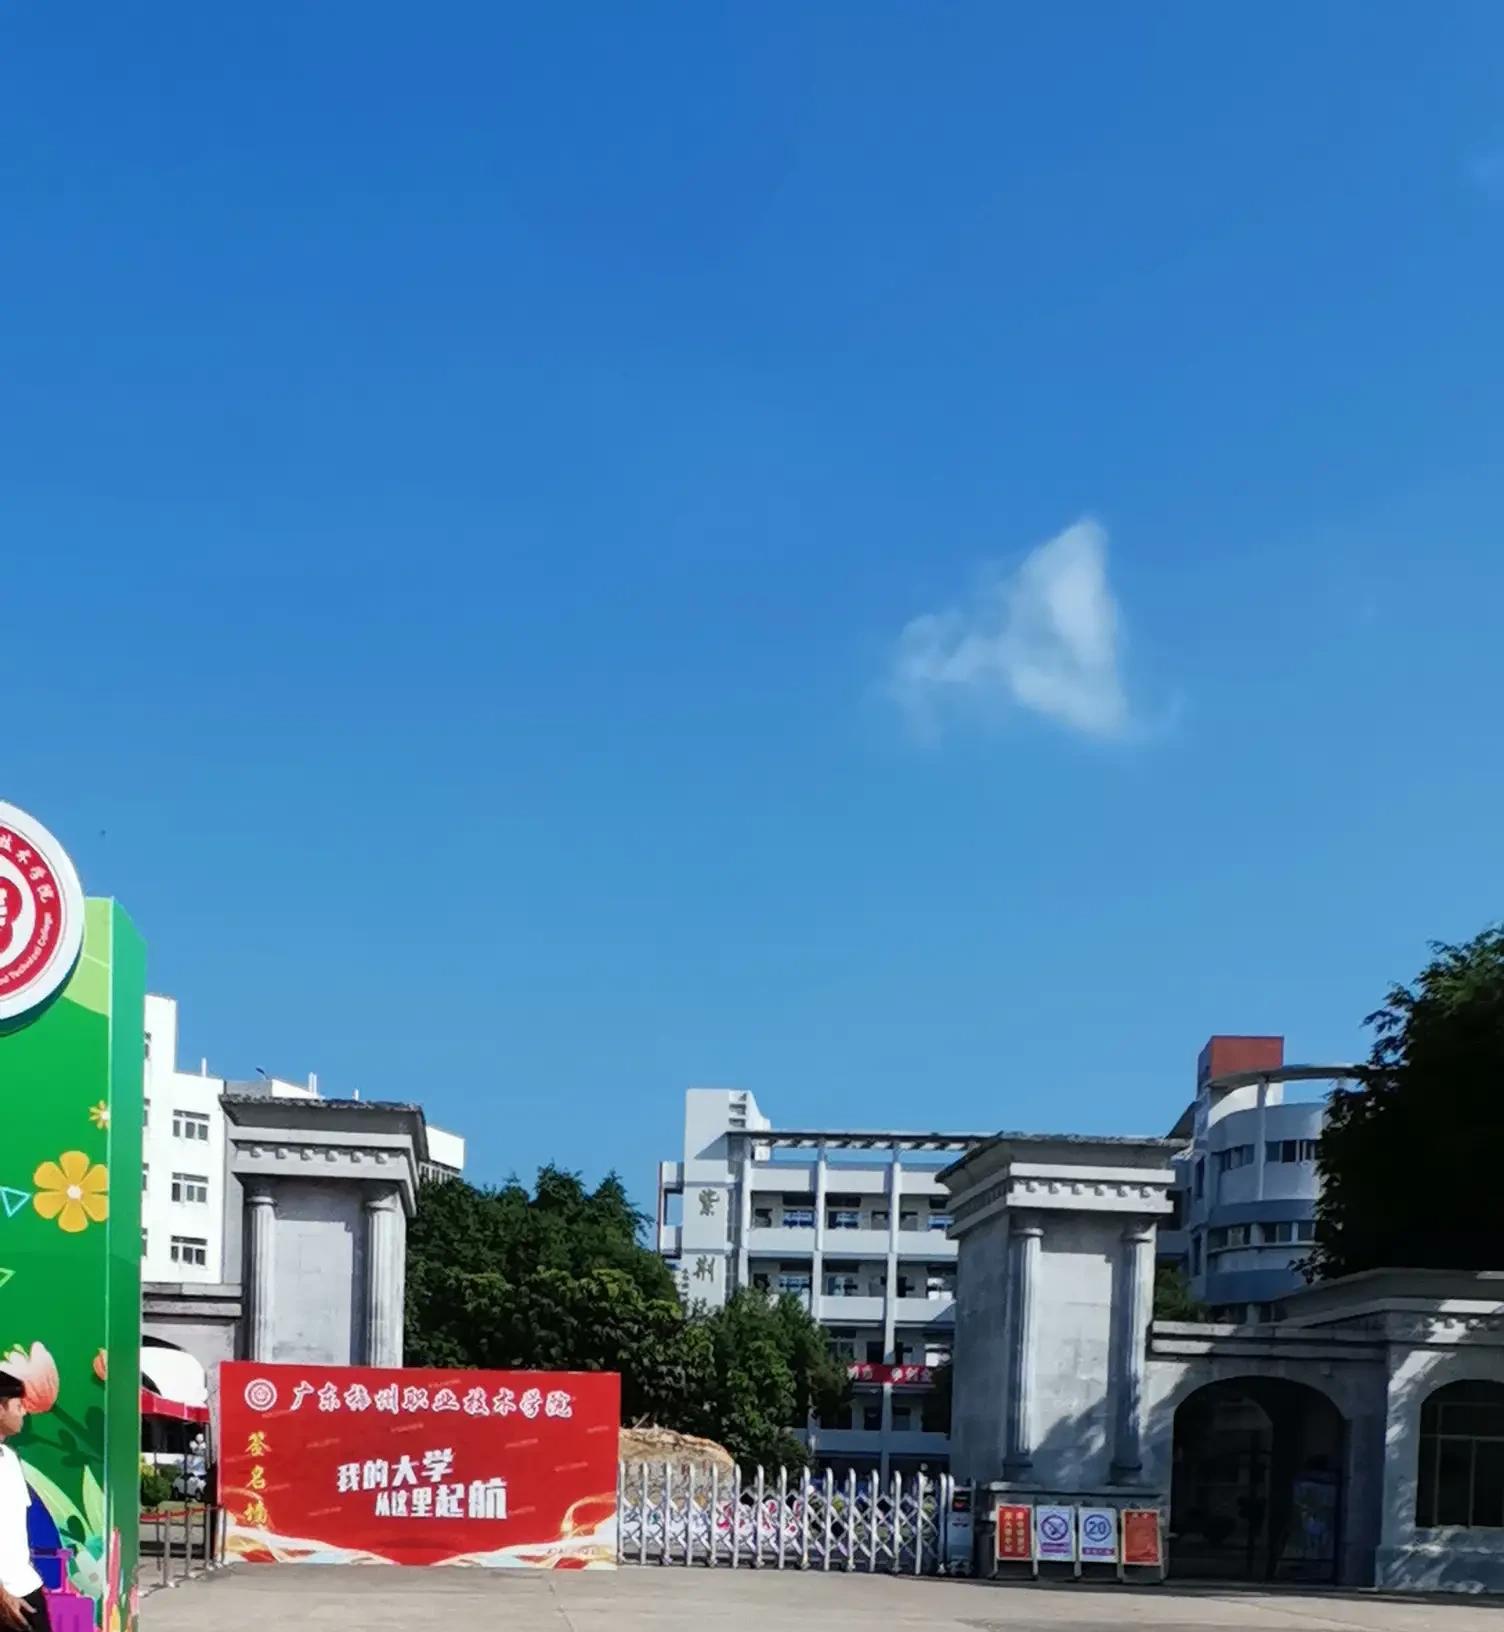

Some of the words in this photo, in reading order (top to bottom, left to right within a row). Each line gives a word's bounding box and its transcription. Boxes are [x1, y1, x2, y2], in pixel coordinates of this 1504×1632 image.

[37, 911, 54, 947] College
[337, 1448, 453, 1492] 我的大学
[375, 1477, 508, 1520] 从这里起航
[1089, 1520, 1106, 1535] 20
